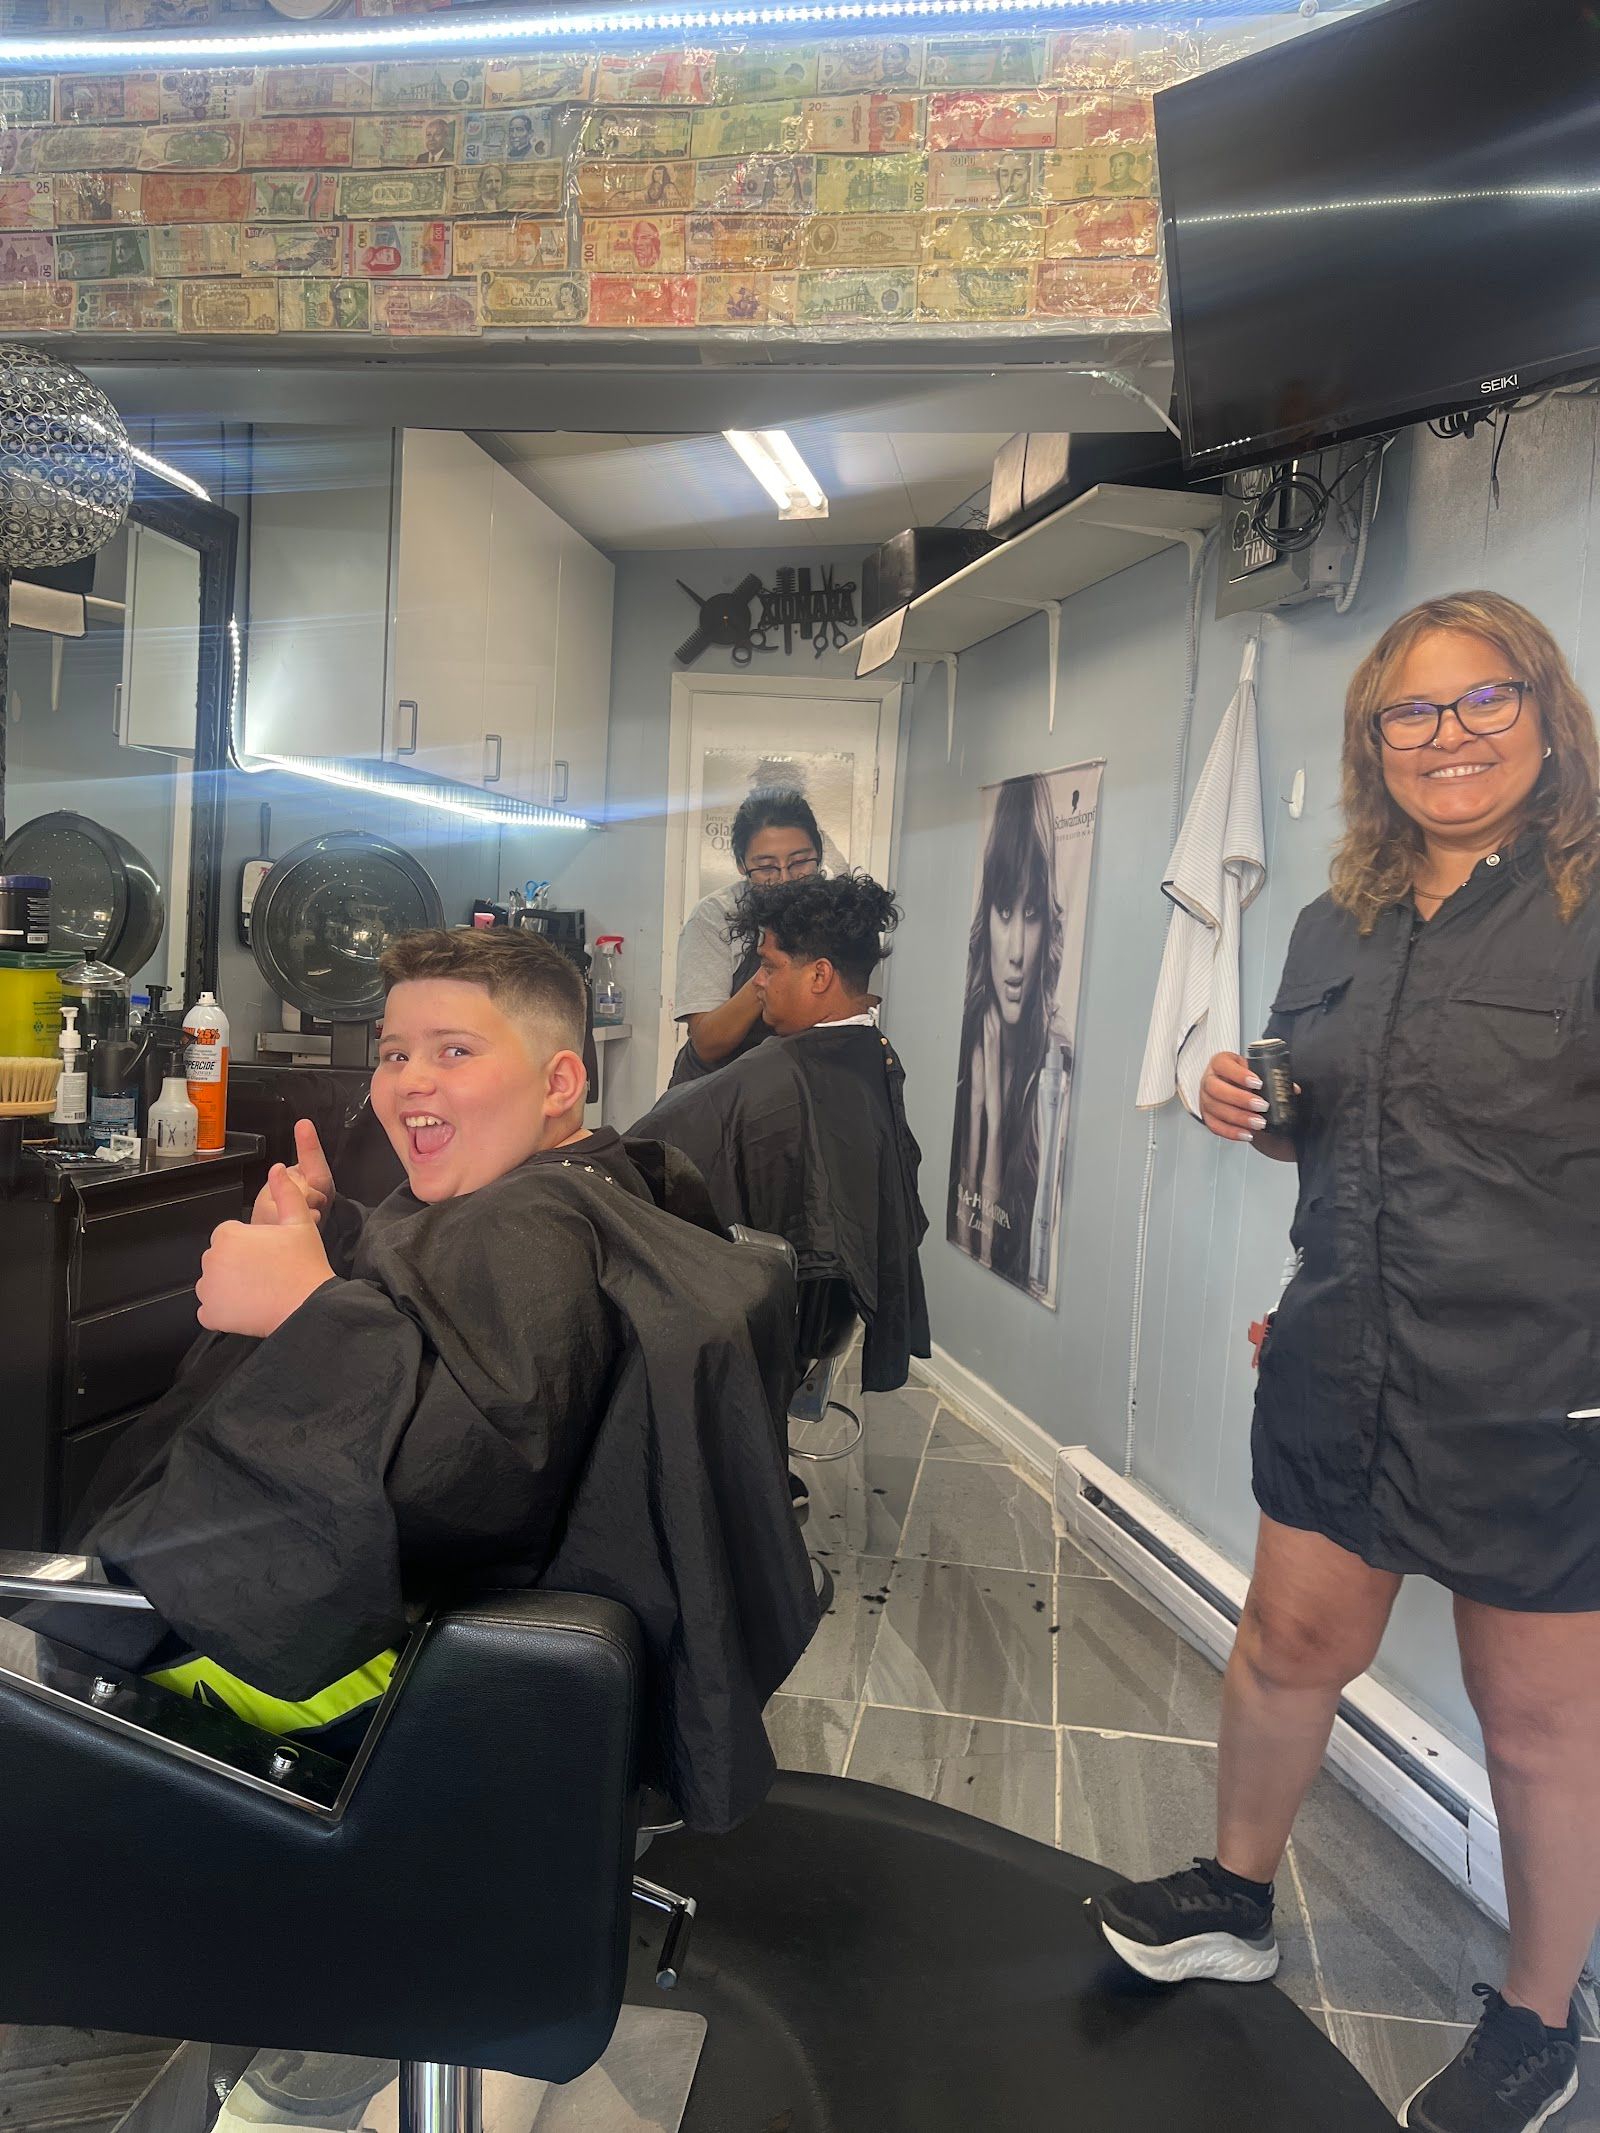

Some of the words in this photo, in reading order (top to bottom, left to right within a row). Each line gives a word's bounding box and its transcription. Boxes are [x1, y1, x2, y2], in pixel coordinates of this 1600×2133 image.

[808, 102, 822, 112] 20
[162, 113, 169, 124] 5
[1041, 135, 1051, 144] 50
[465, 144, 476, 158] 20
[36, 182, 50, 194] 25
[914, 182, 924, 202] 200
[255, 207, 267, 216] 20
[584, 243, 594, 263] 100
[43, 265, 52, 277] 50
[510, 297, 553, 306] CANADA
[1480, 374, 1518, 394] SEIKI
[760, 591, 856, 622] XIOMARA
